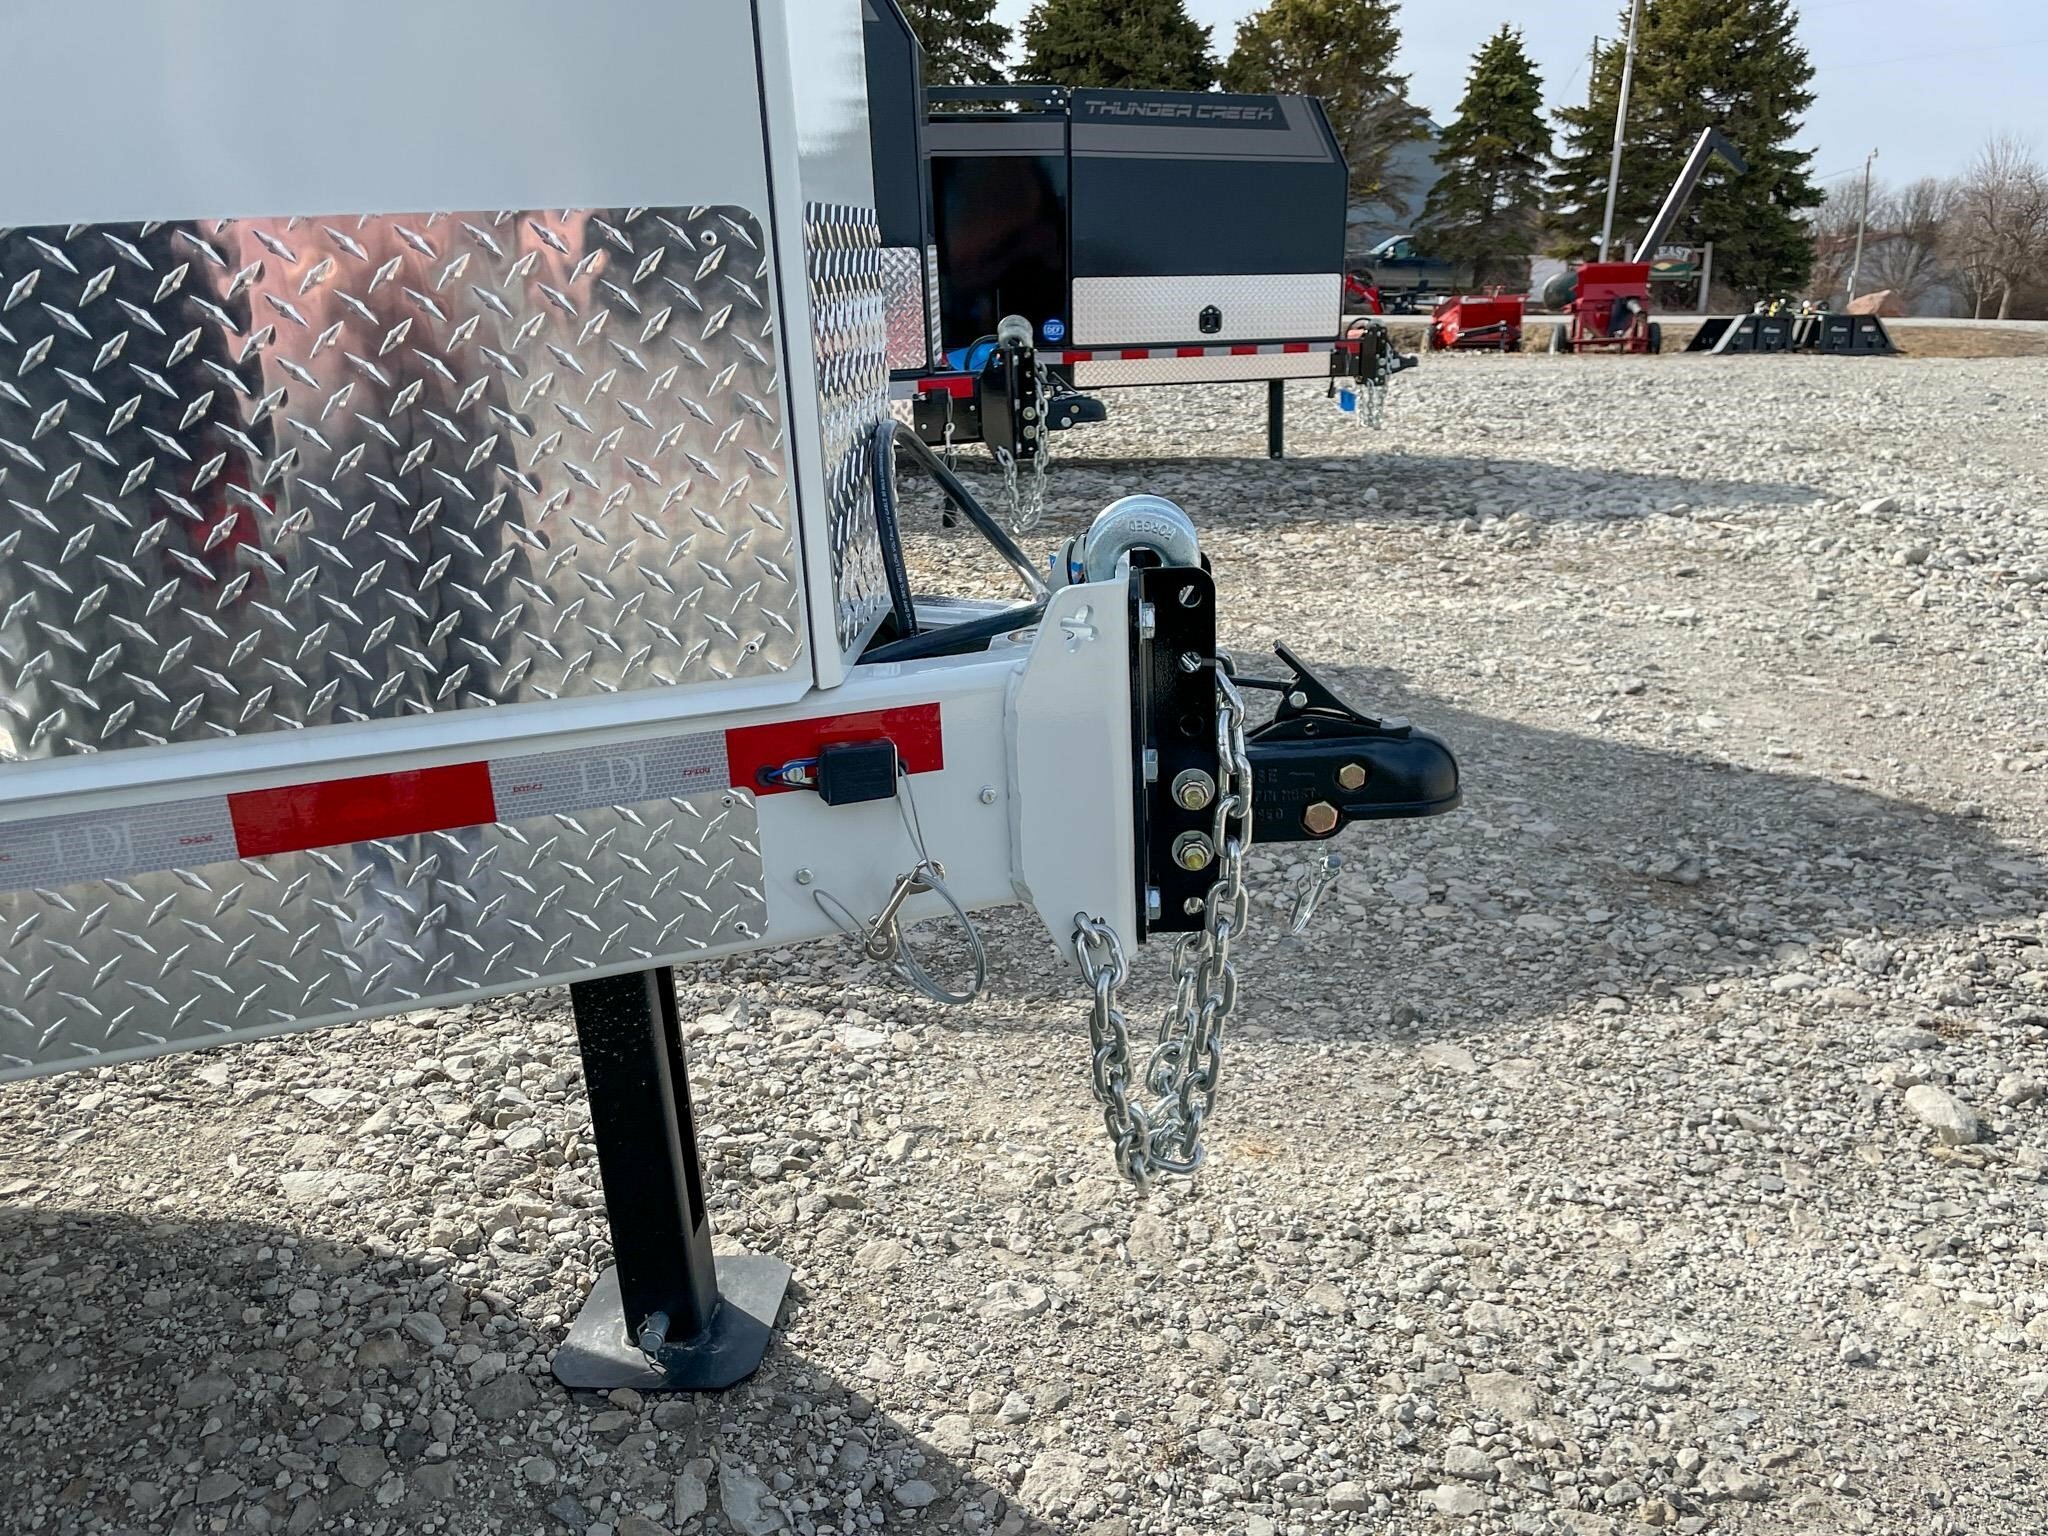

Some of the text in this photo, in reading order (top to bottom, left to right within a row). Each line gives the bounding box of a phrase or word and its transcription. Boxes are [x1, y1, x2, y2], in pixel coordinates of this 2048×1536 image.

[1085, 100, 1274, 121] THUNDER CREEK
[1128, 520, 1176, 541] FORGED
